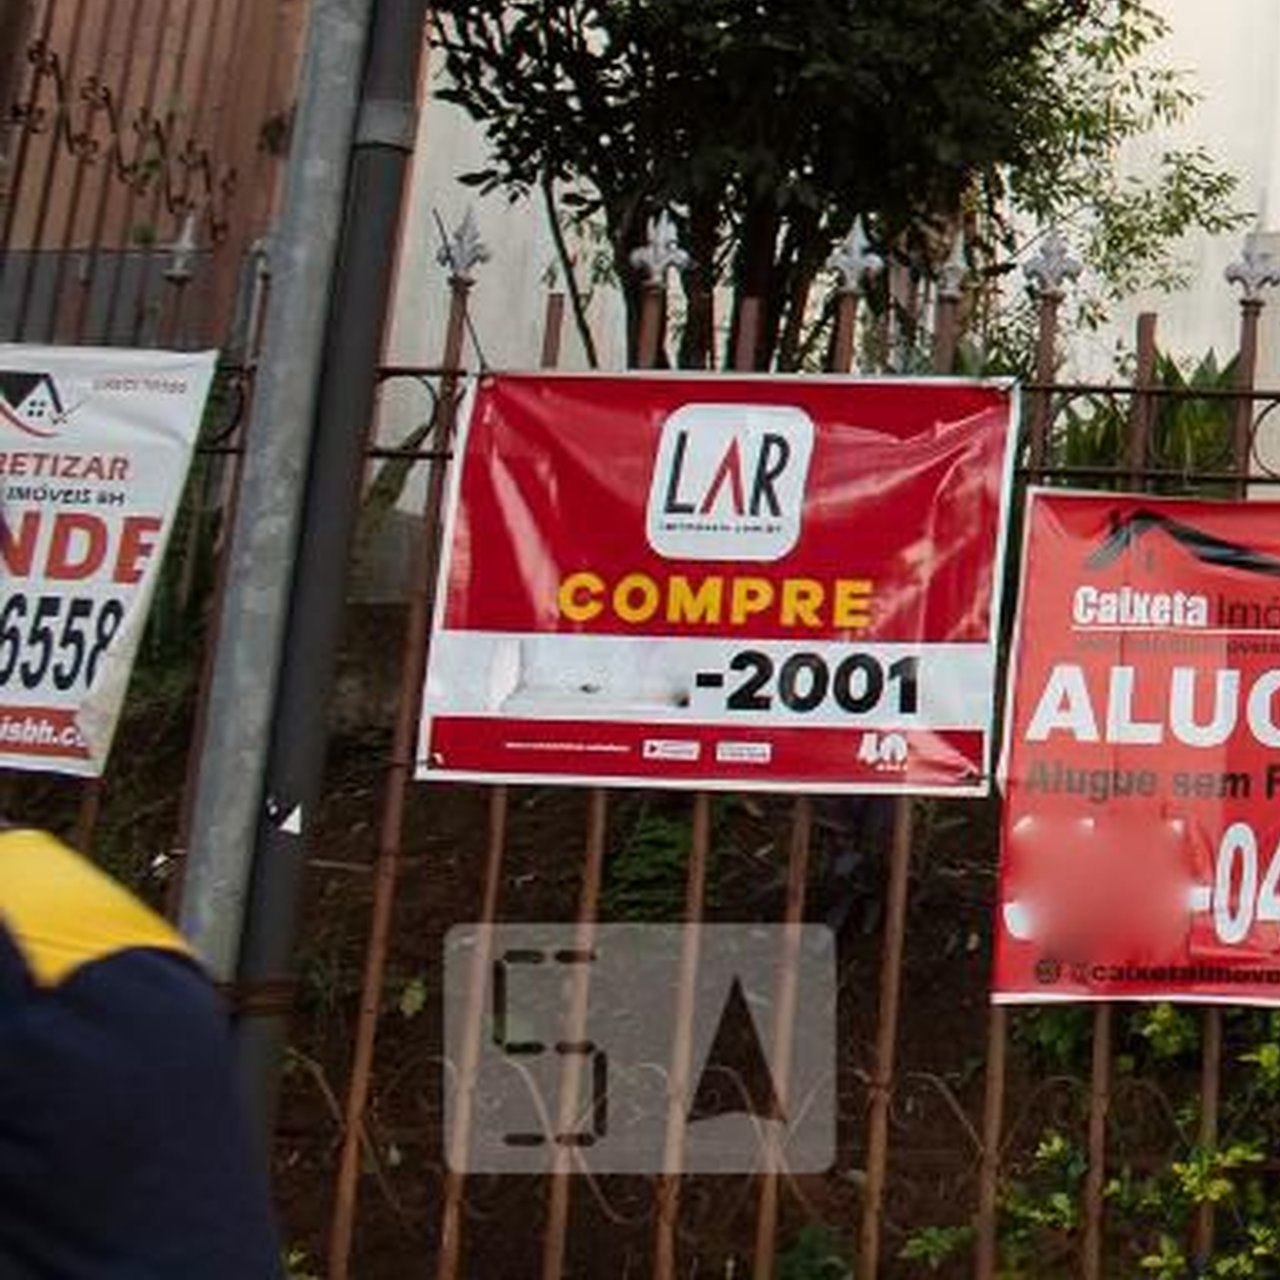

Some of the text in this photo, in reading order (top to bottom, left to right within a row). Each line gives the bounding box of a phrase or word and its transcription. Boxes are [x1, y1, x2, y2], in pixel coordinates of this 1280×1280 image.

[663, 430, 790, 517] LAR
[557, 571, 876, 628] COMPRE
[1072, 586, 1209, 627] Caixeta
[1024, 760, 1158, 802] Alugue
[1172, 769, 1251, 799] sem
